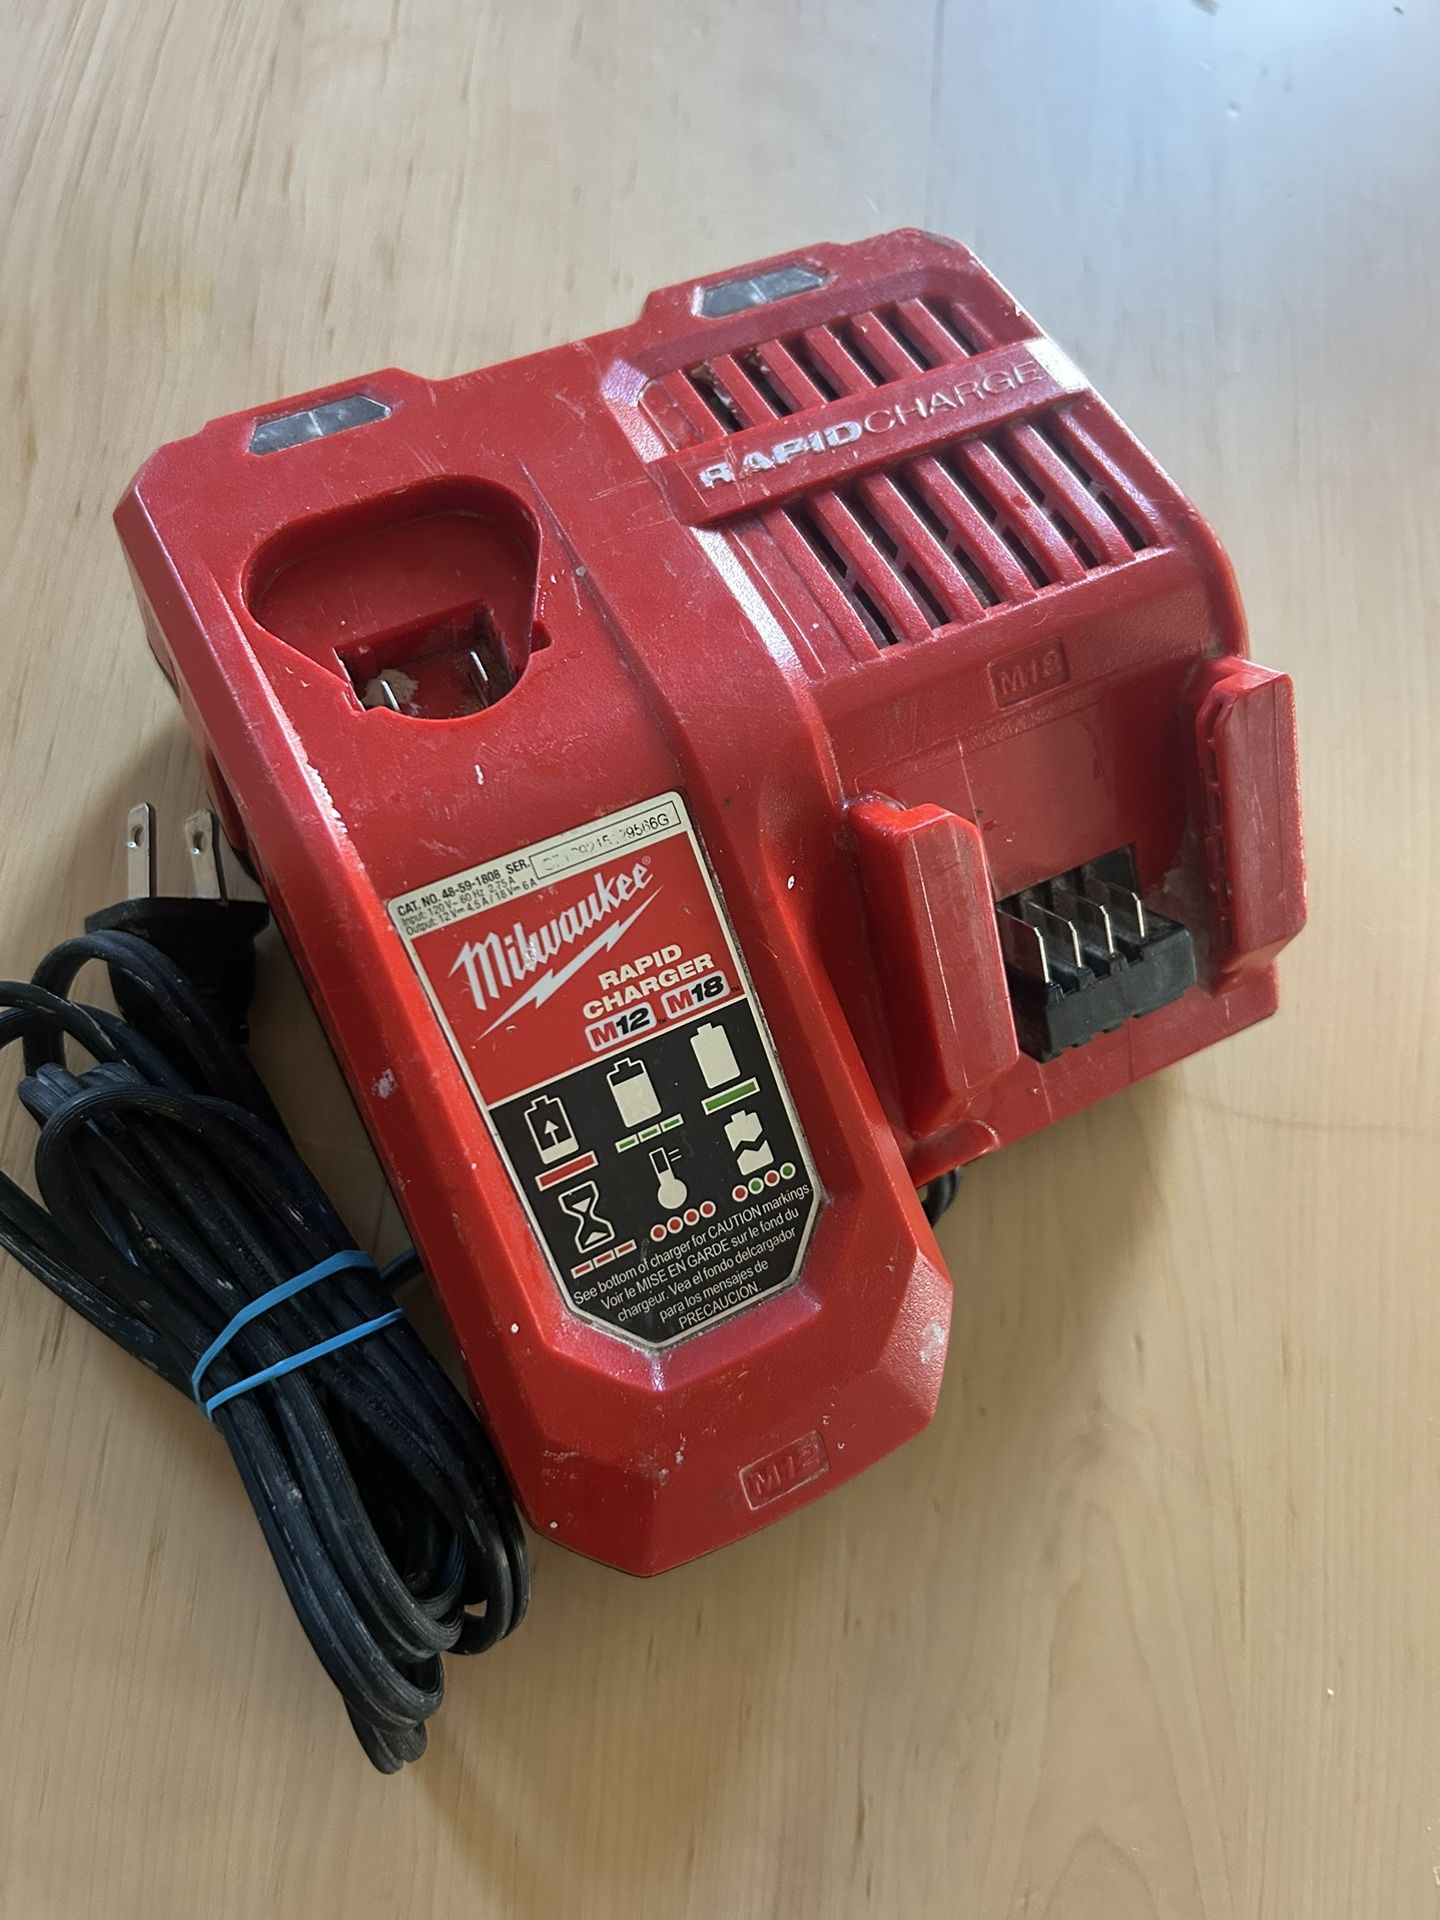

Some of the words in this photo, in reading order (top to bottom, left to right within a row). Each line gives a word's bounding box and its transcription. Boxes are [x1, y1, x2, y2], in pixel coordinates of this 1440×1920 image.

[1000, 650, 1059, 695] M18
[397, 900, 421, 916] CAT.
[421, 893, 441, 907] NO.
[442, 869, 501, 898] 48-59-1808
[505, 859, 530, 874] SER.
[401, 911, 427, 927] Input:
[428, 903, 445, 916] 120
[459, 893, 472, 904] 60
[472, 889, 485, 898] Hz
[405, 918, 437, 936] Output:
[438, 912, 451, 922] 12
[494, 889, 507, 900] 18
[522, 881, 529, 890] 6
[530, 878, 537, 887] A
[448, 863, 653, 1011] Milwaukee
[598, 944, 683, 991] RAPID
[582, 953, 715, 1020] CHARGER
[589, 1006, 651, 1047] M12
[665, 975, 724, 1015] M18
[573, 1287, 598, 1304] See
[597, 1268, 637, 1293] bottom
[638, 1257, 649, 1273] of
[650, 1240, 691, 1267] charger
[691, 1233, 706, 1247] for
[708, 1204, 762, 1239] CAUTION
[762, 1184, 814, 1213] markings.
[600, 1292, 623, 1309] Voir
[624, 1287, 636, 1299] le
[636, 1269, 668, 1293] MISE
[667, 1259, 687, 1278] EN
[687, 1238, 730, 1268] GARDE
[731, 1231, 748, 1247] sur
[748, 1227, 759, 1238] le
[759, 1212, 784, 1233] fond
[785, 1208, 799, 1221] du
[618, 1291, 669, 1322] chargeur.
[668, 1279, 692, 1295] Vea
[692, 1271, 703, 1285] el
[703, 1258, 734, 1279] fondo
[659, 1301, 685, 1323] para
[684, 1293, 702, 1307] los
[703, 1267, 754, 1299] mensajes
[754, 1260, 768, 1273] de
